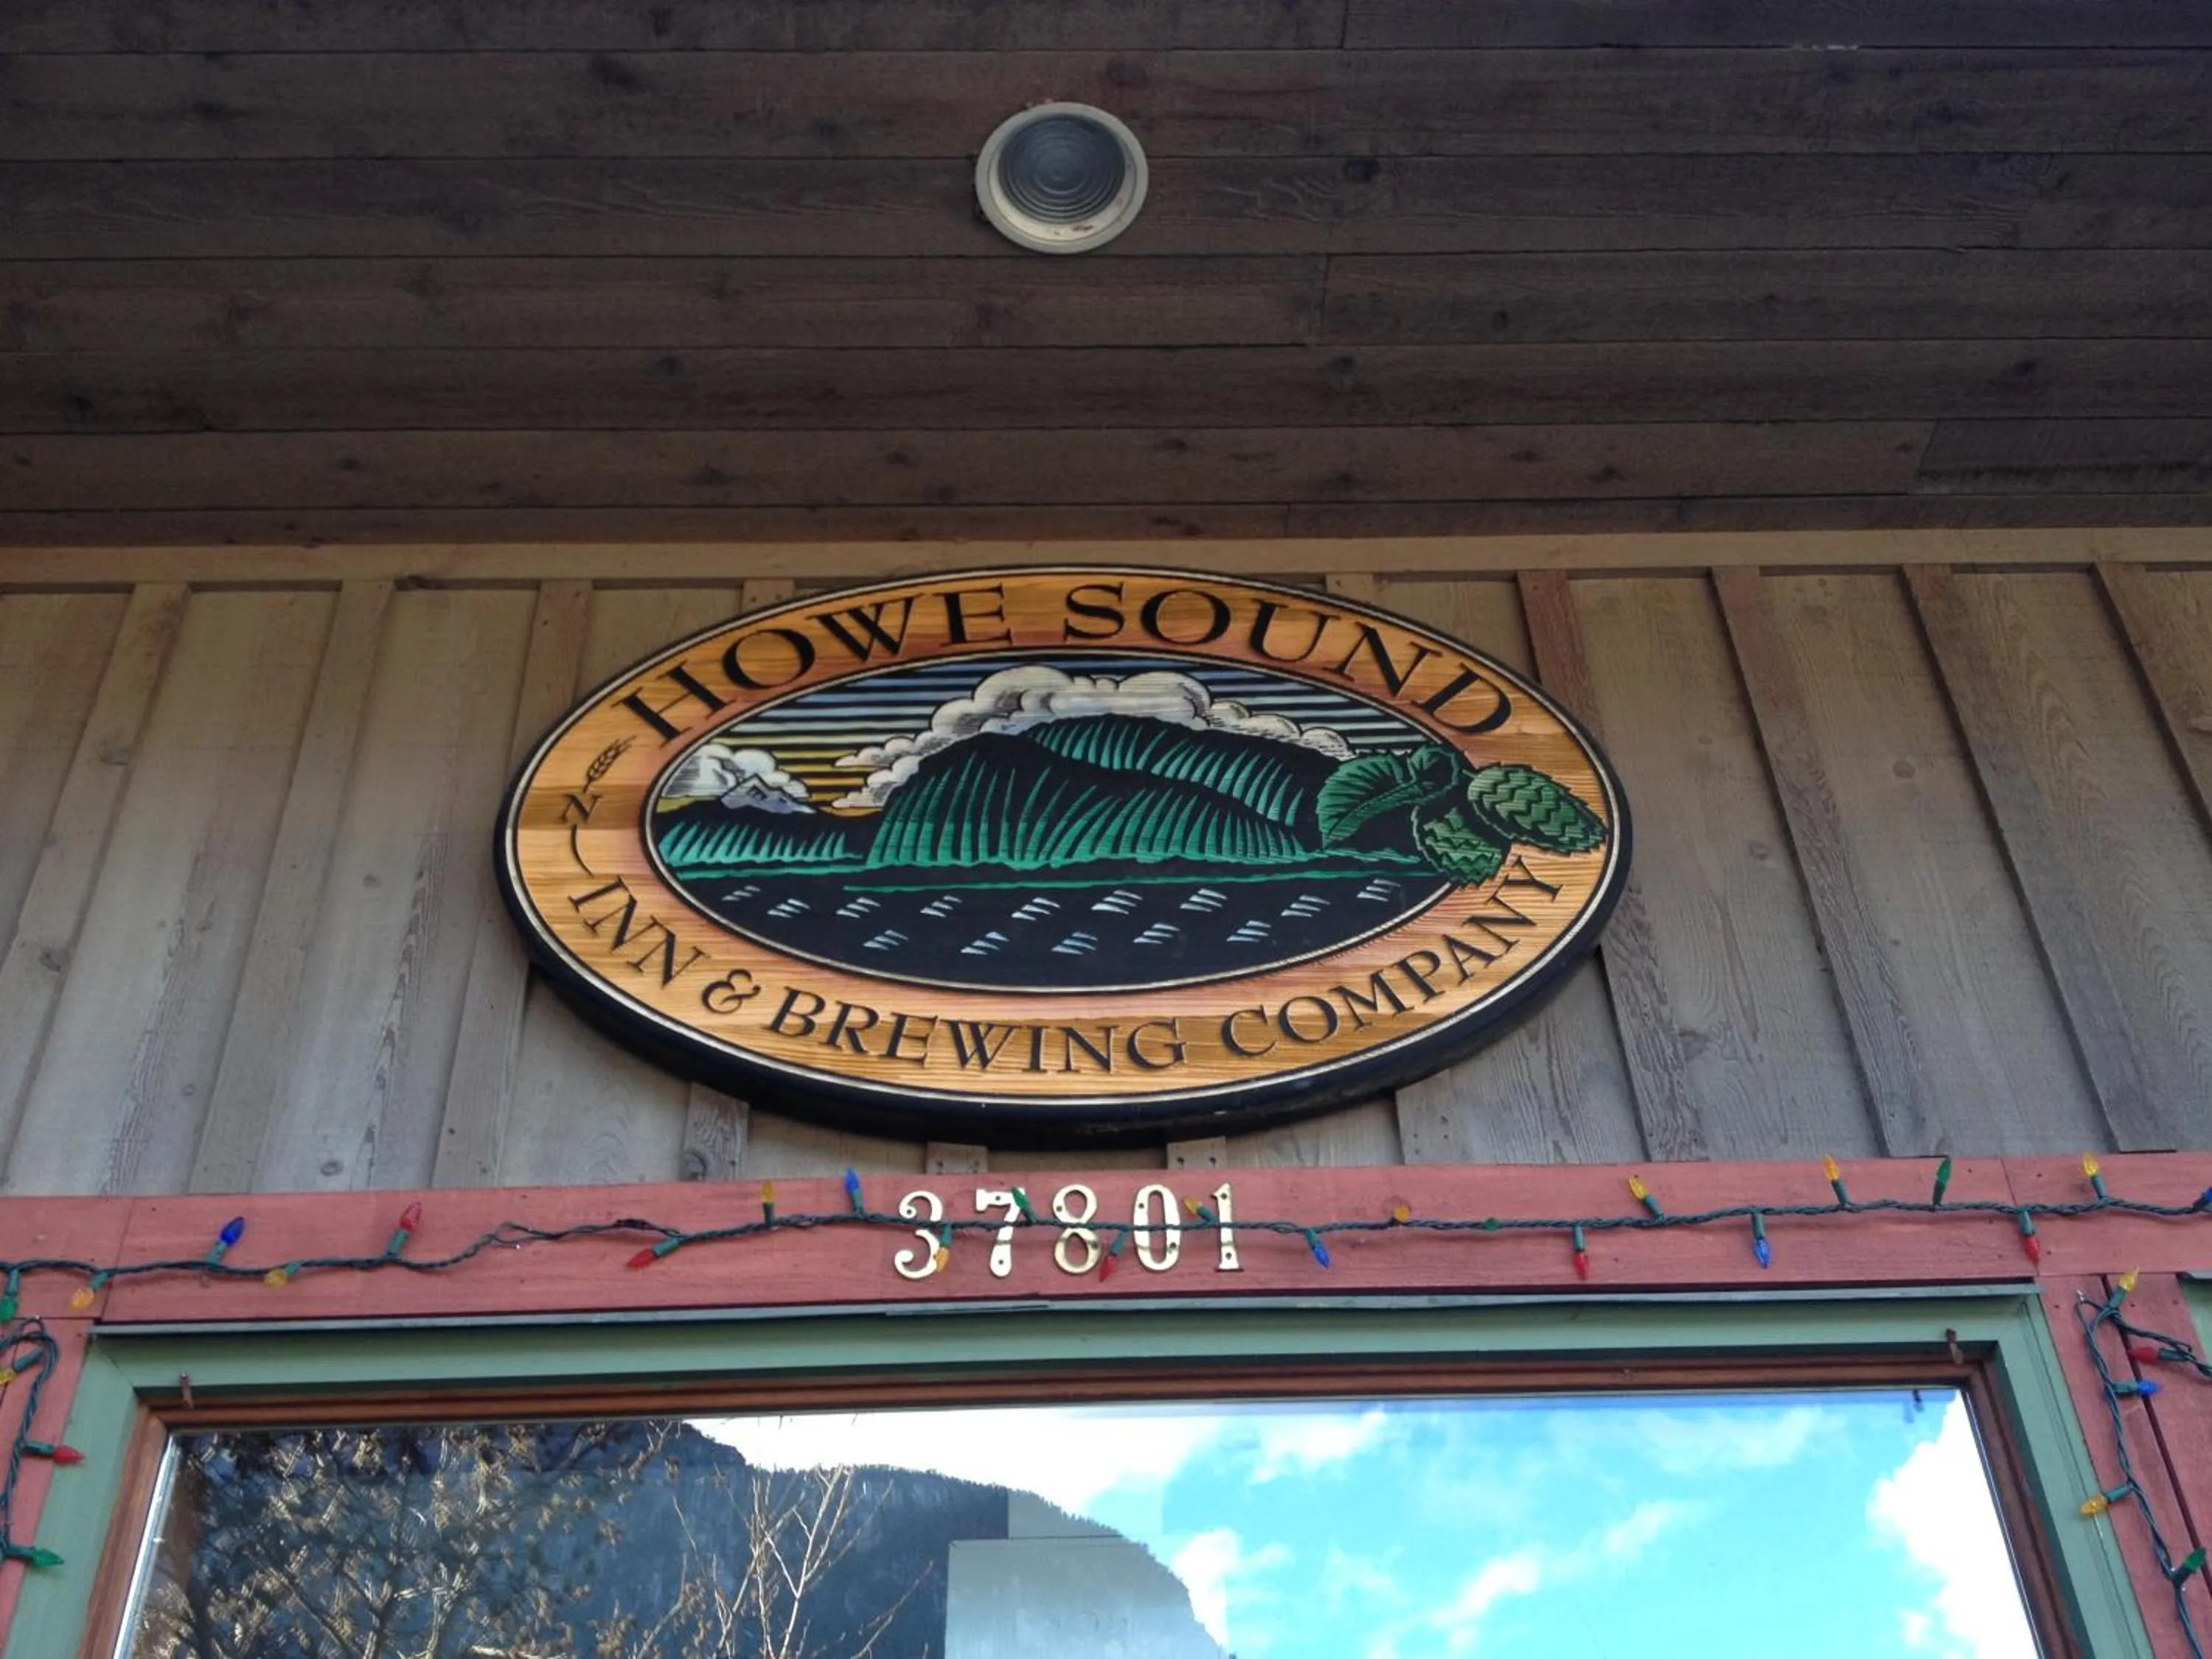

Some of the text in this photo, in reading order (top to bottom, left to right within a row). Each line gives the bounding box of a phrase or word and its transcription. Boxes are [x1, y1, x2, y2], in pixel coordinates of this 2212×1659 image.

[612, 581, 1512, 749] HOWE SOUND
[567, 855, 1563, 1074] INN & BREWING COMPANY
[894, 1182, 1244, 1279] 37801
